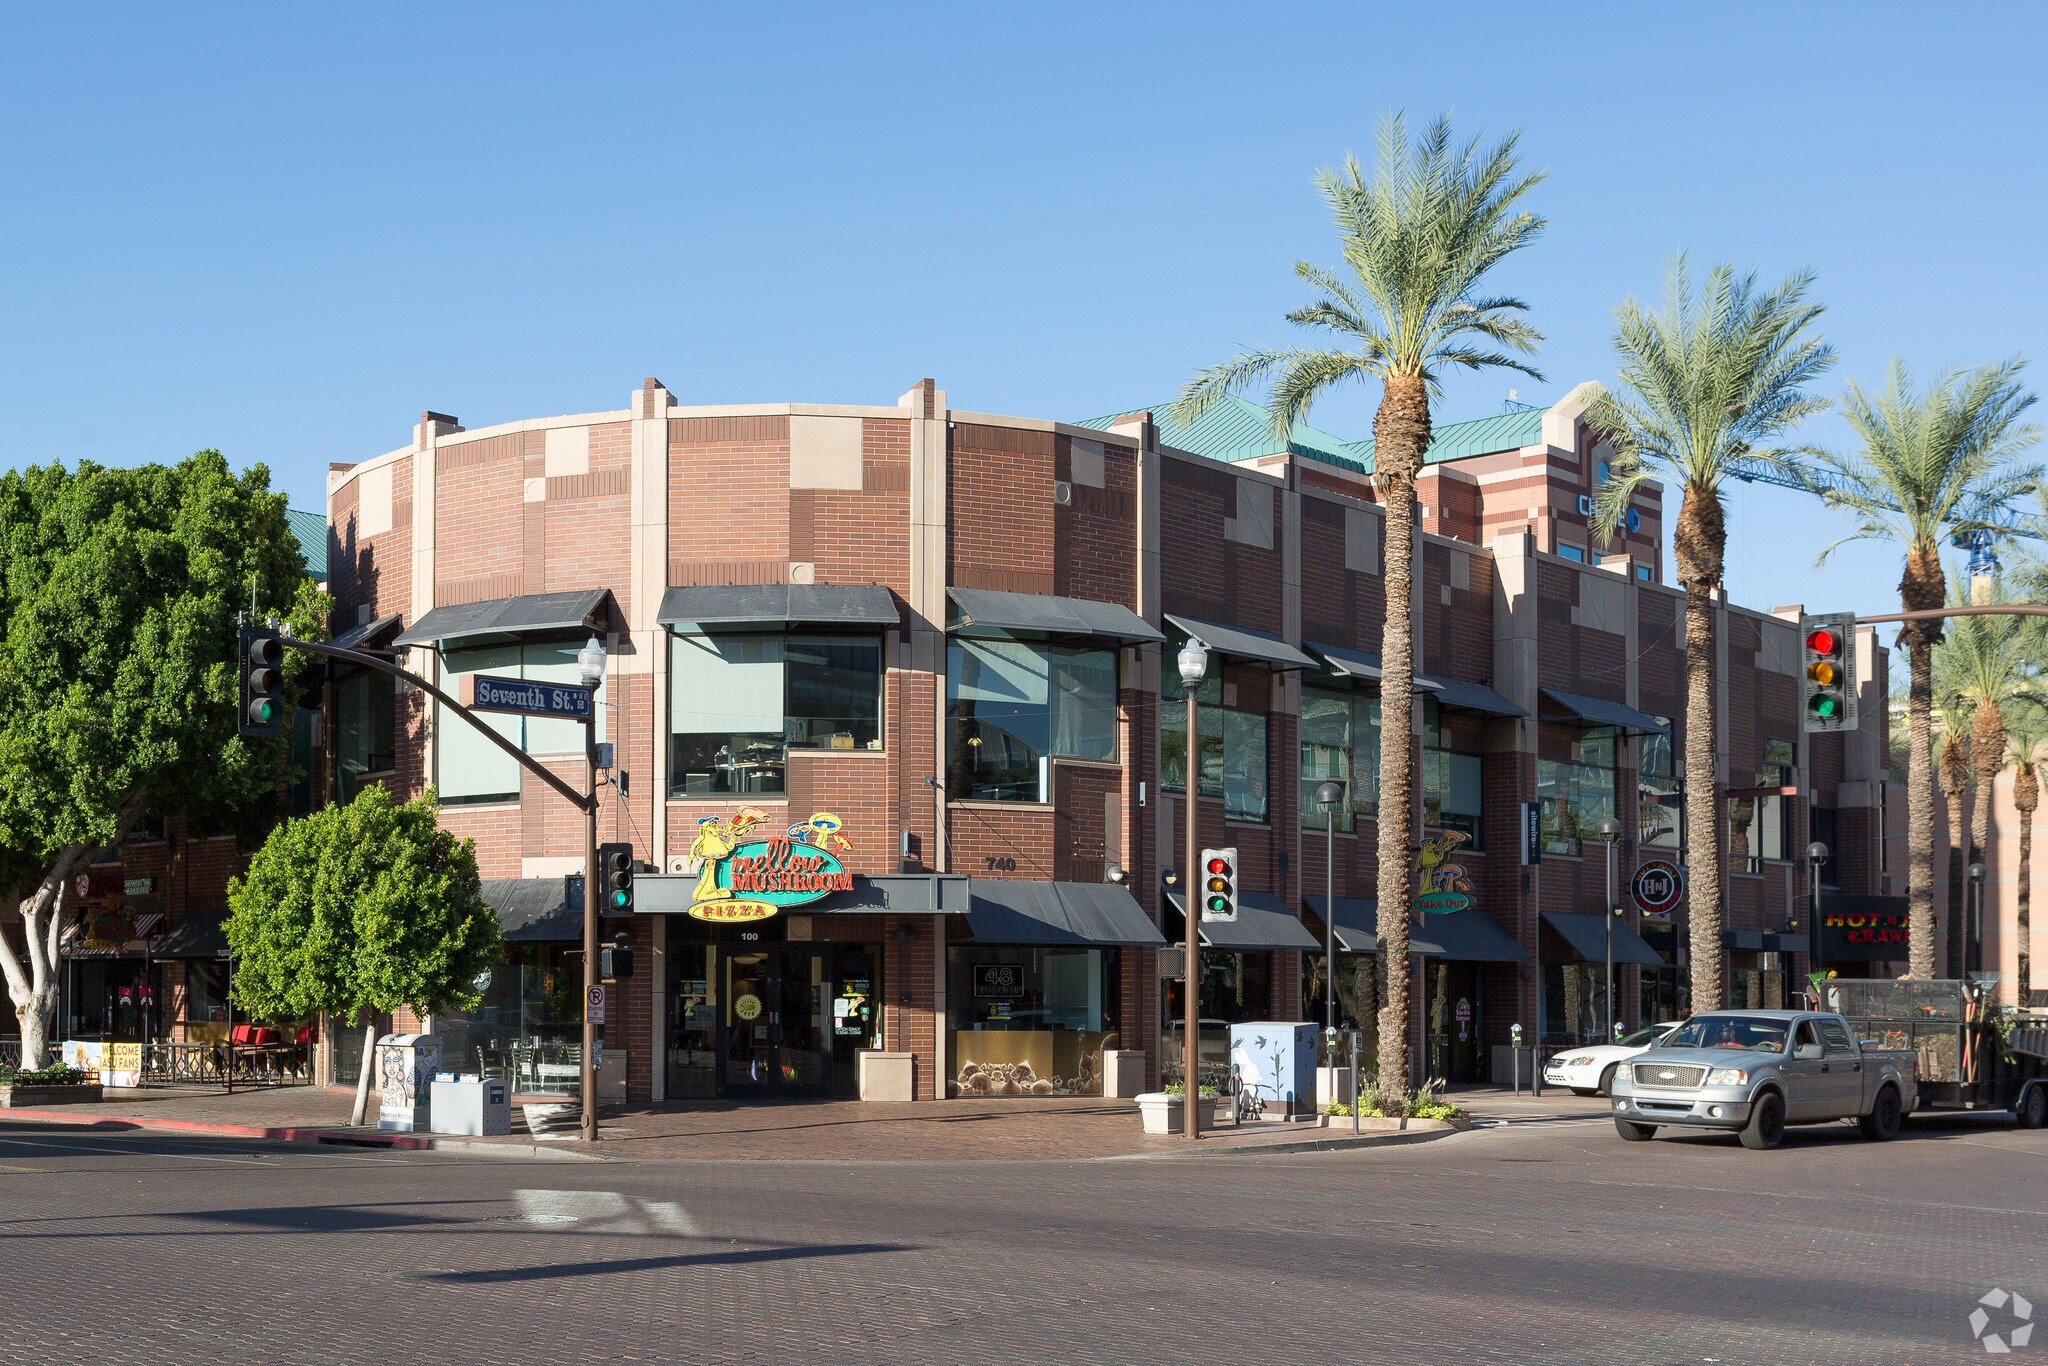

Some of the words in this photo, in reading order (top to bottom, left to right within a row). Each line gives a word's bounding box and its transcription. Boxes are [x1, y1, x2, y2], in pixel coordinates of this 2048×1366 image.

[480, 683, 546, 708] Seventh
[552, 690, 574, 710] St.
[731, 836, 827, 873] mellow
[985, 857, 1016, 872] 740
[731, 872, 855, 892] MUSHROOM
[702, 904, 767, 918] PIZZA
[1418, 899, 1443, 909] Take
[1445, 898, 1465, 908] Out
[1826, 912, 1880, 927] HOT
[741, 932, 759, 941] 100
[985, 967, 1014, 986] 48
[102, 1045, 139, 1056] WELCOME
[102, 1058, 118, 1068] ASU
[120, 1058, 139, 1069] FANS
